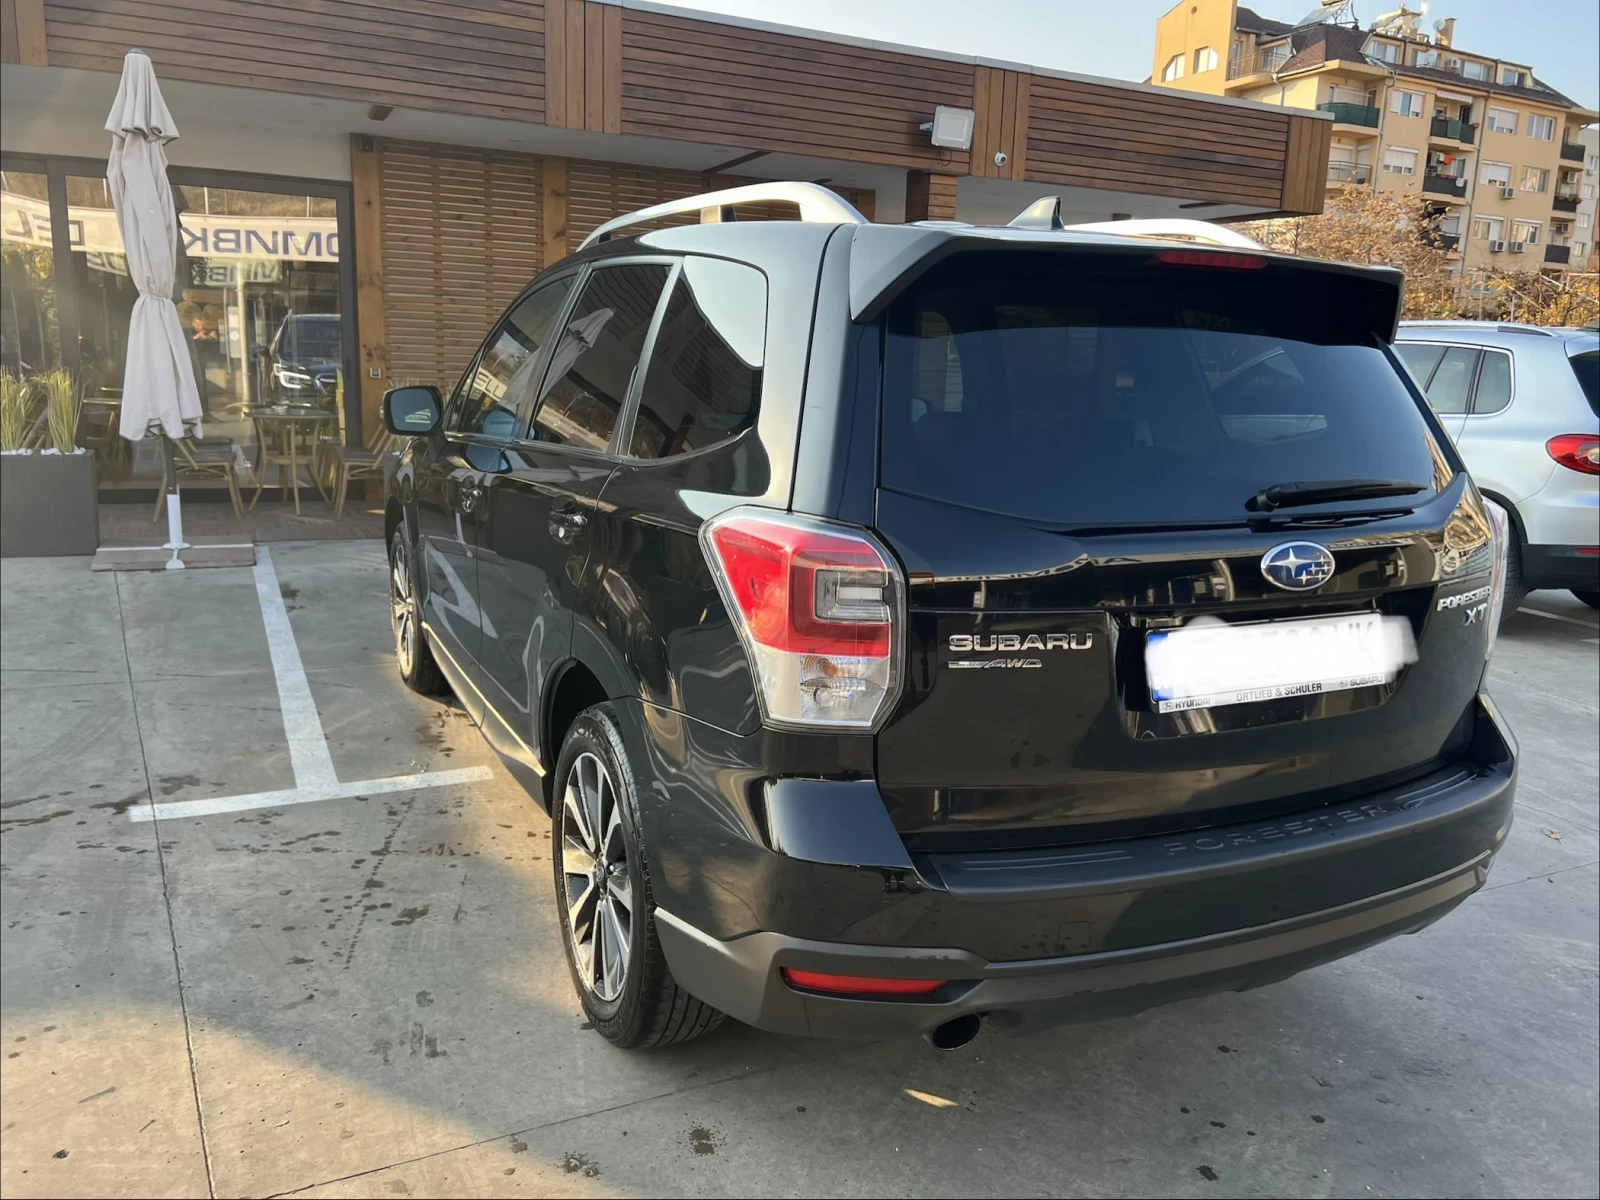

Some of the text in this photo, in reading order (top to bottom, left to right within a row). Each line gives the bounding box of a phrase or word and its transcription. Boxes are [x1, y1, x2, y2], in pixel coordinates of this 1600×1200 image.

[1437, 585, 1491, 611] FORESTER
[1463, 603, 1487, 626] XT
[949, 633, 1093, 651] SUBARU
[984, 658, 1043, 669] AWD
[1350, 676, 1383, 687] SUBARU
[1236, 688, 1273, 702] ORTLIEB
[1275, 687, 1283, 697] &
[1162, 805, 1388, 856] FORESTER
